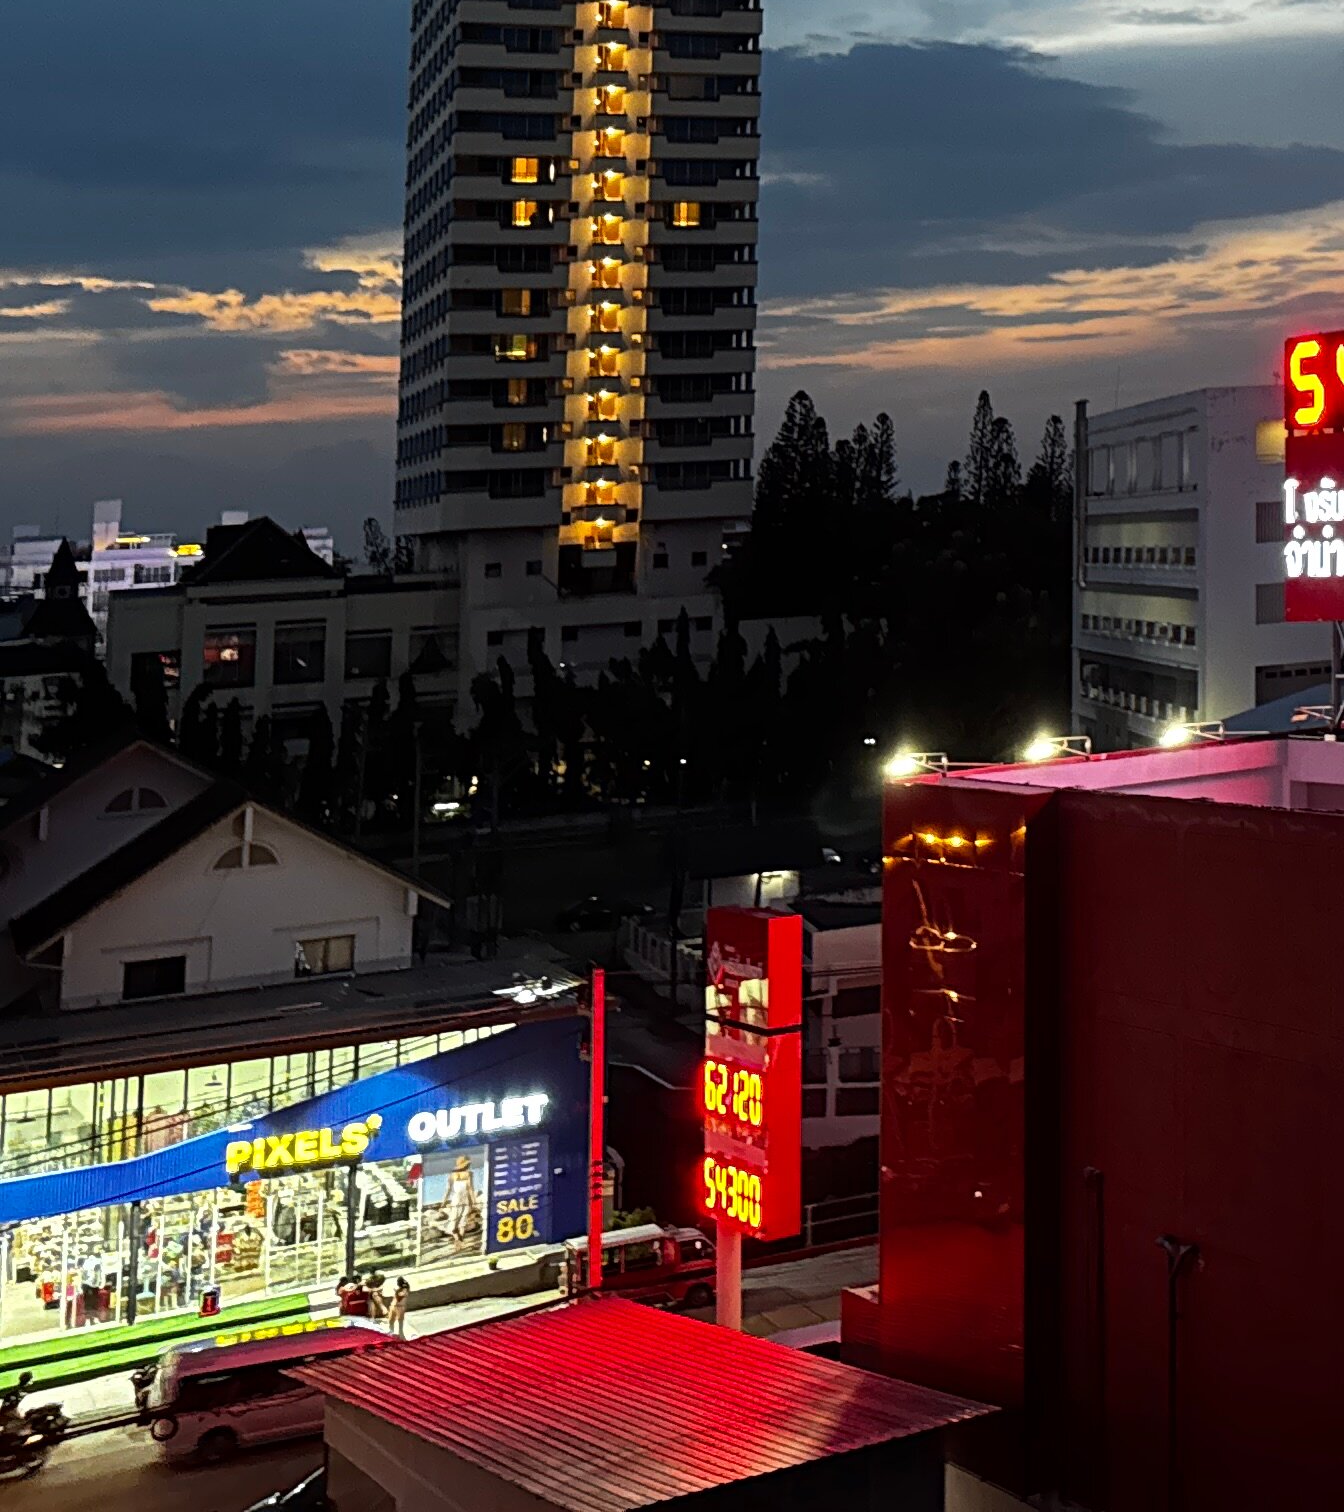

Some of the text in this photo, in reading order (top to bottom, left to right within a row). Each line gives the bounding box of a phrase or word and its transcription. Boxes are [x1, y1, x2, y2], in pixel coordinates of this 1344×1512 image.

[408, 1093, 549, 1142] OUTLET
[703, 1060, 762, 1126] 62120
[496, 1194, 539, 1215] SALE
[703, 1156, 762, 1228] 54300
